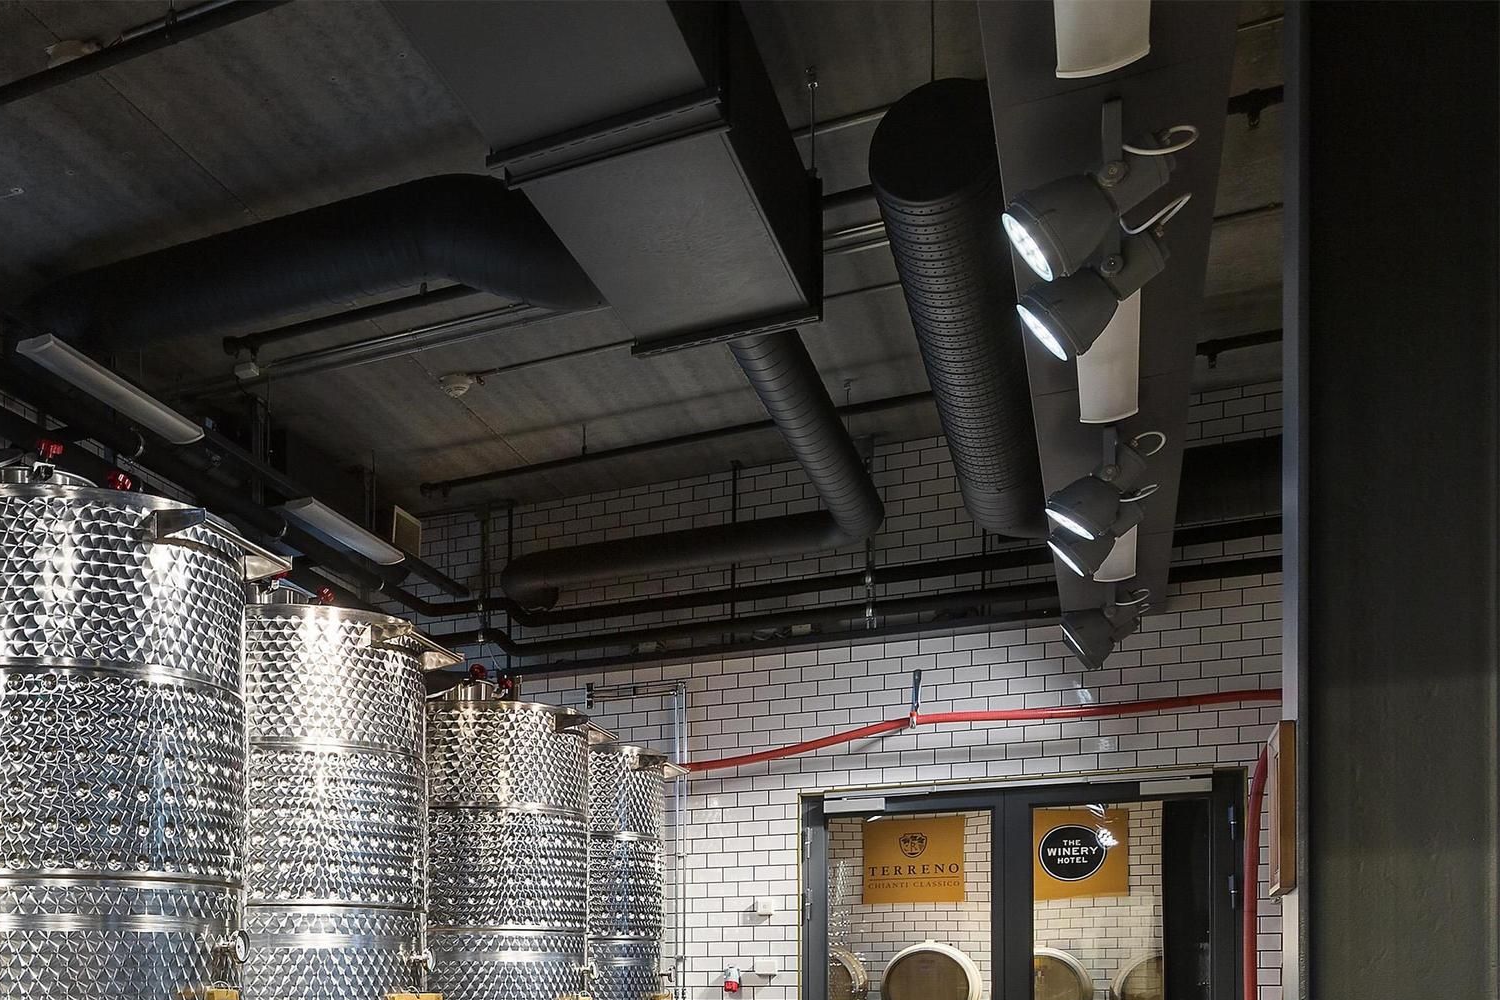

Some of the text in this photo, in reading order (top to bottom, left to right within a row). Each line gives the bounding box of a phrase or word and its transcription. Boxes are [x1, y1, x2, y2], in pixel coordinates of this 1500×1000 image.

[1046, 846, 1099, 857] WINERY
[1057, 856, 1089, 864] HOTEL
[868, 863, 960, 877] TERRENO
[913, 880, 960, 888] CLASSICO
